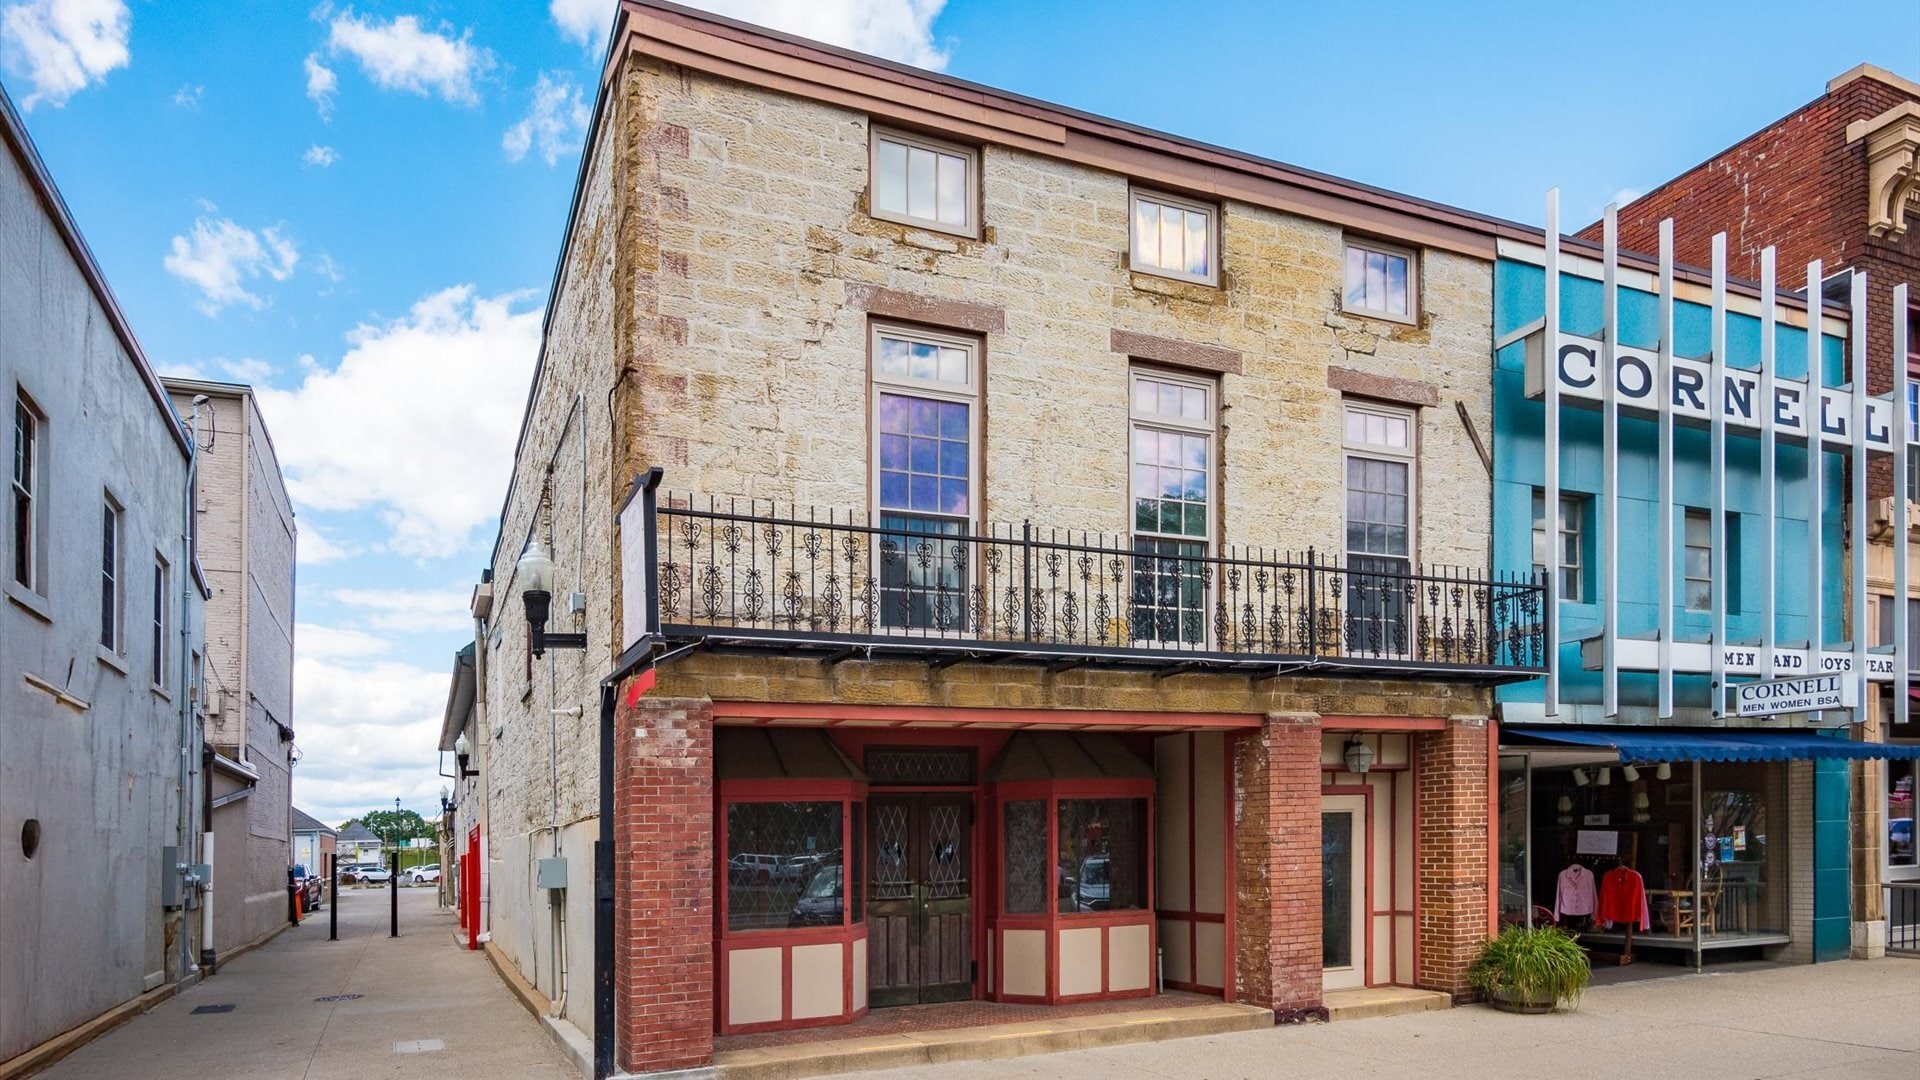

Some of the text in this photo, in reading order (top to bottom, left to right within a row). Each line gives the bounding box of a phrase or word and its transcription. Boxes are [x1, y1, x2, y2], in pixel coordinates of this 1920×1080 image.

[1558, 344, 1890, 444] CORNELL
[1725, 652, 1755, 666] MEN
[1774, 655, 1802, 668] AND
[1866, 660, 1894, 673] EAR
[1742, 677, 1840, 700] CORNELL
[1743, 695, 1841, 713] MEN WOMEN BSA
